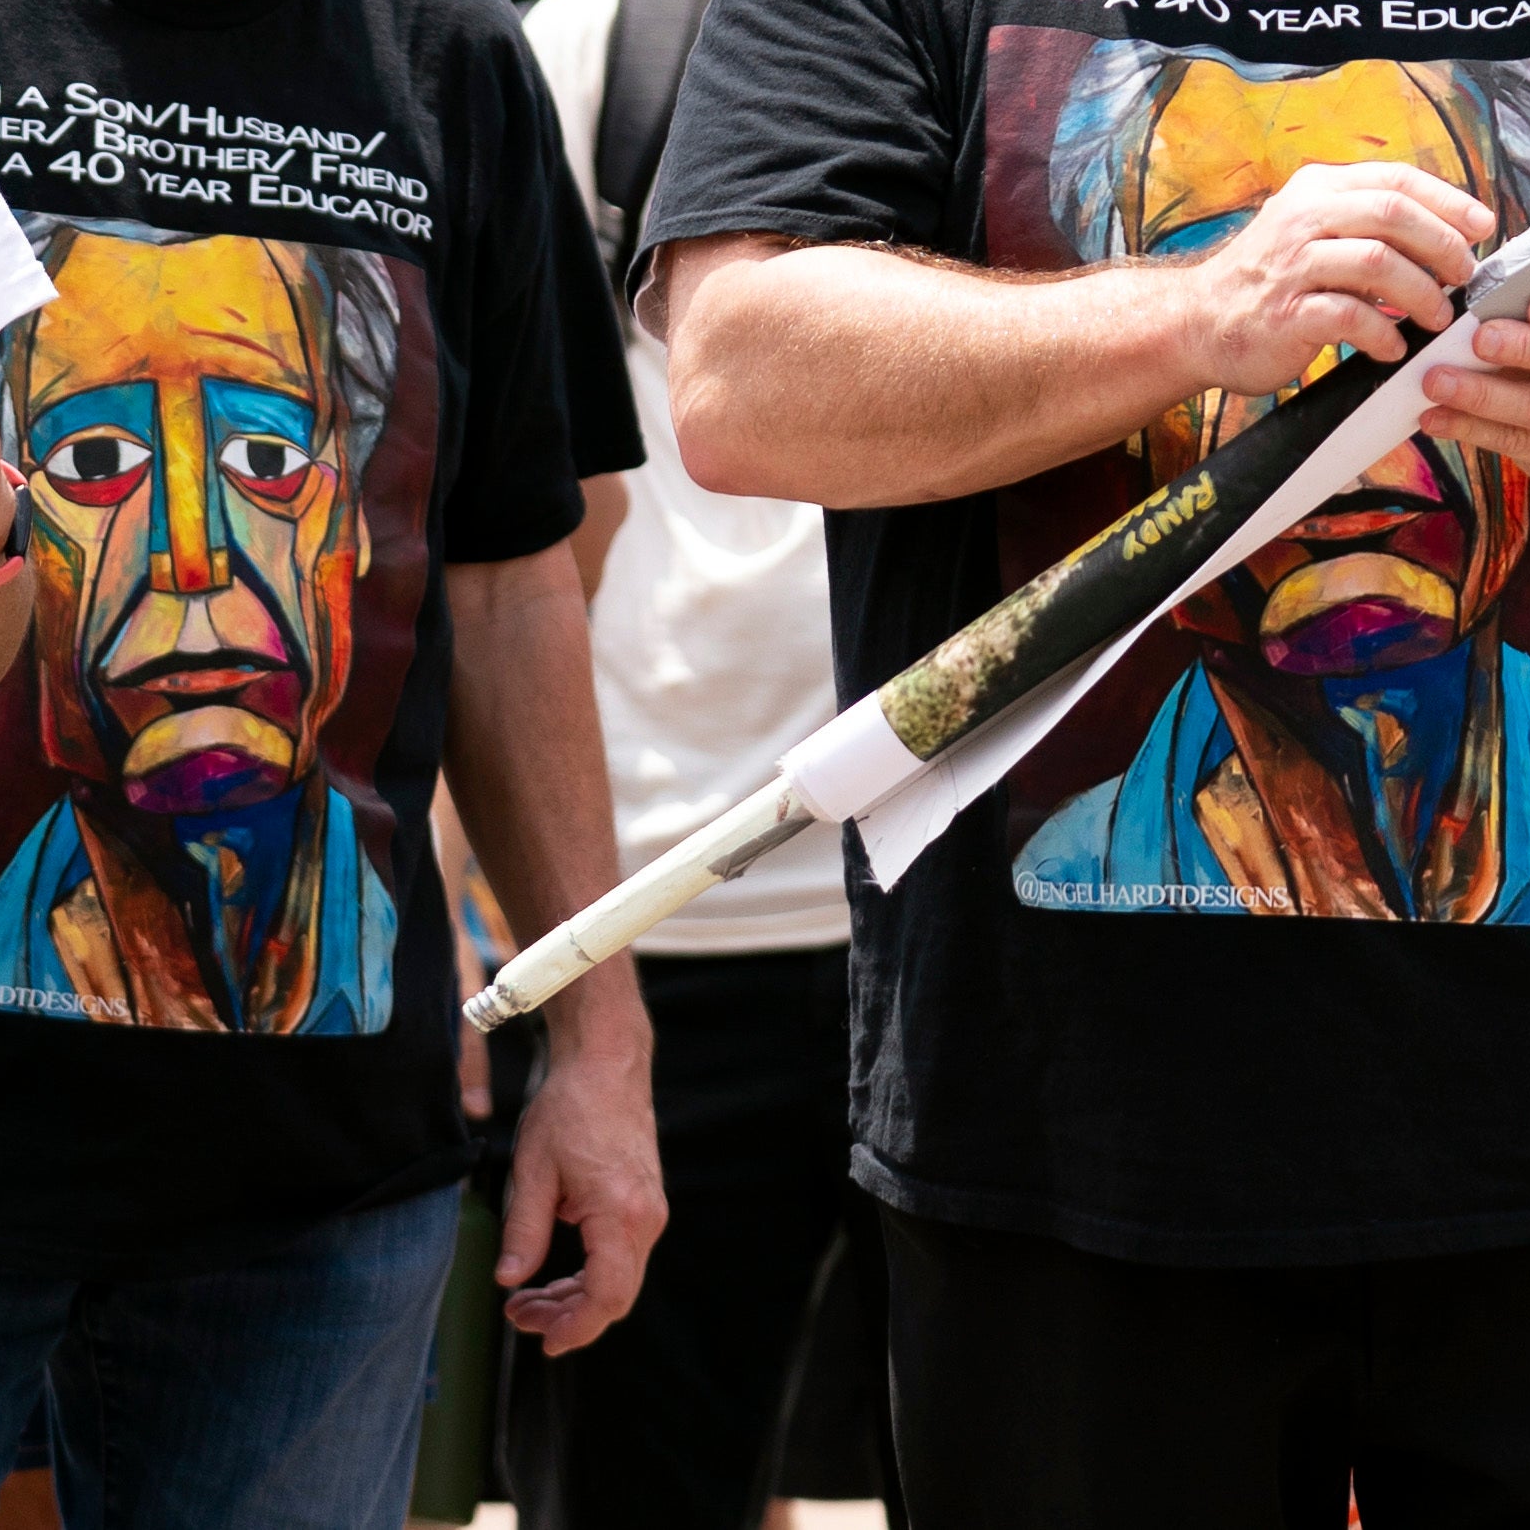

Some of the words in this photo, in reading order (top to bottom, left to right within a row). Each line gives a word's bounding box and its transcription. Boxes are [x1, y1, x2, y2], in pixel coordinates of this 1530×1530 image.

[1248, 5, 1361, 33] YEAR
[15, 85, 50, 111] A
[0, 151, 34, 177] A
[47, 148, 125, 185] 40
[137, 167, 233, 204] YEAR
[249, 174, 433, 242] EDUCATOR
[311, 151, 429, 204] FRIEND
[1014, 872, 1289, 909] @ENGELHARDTDESIGNS
